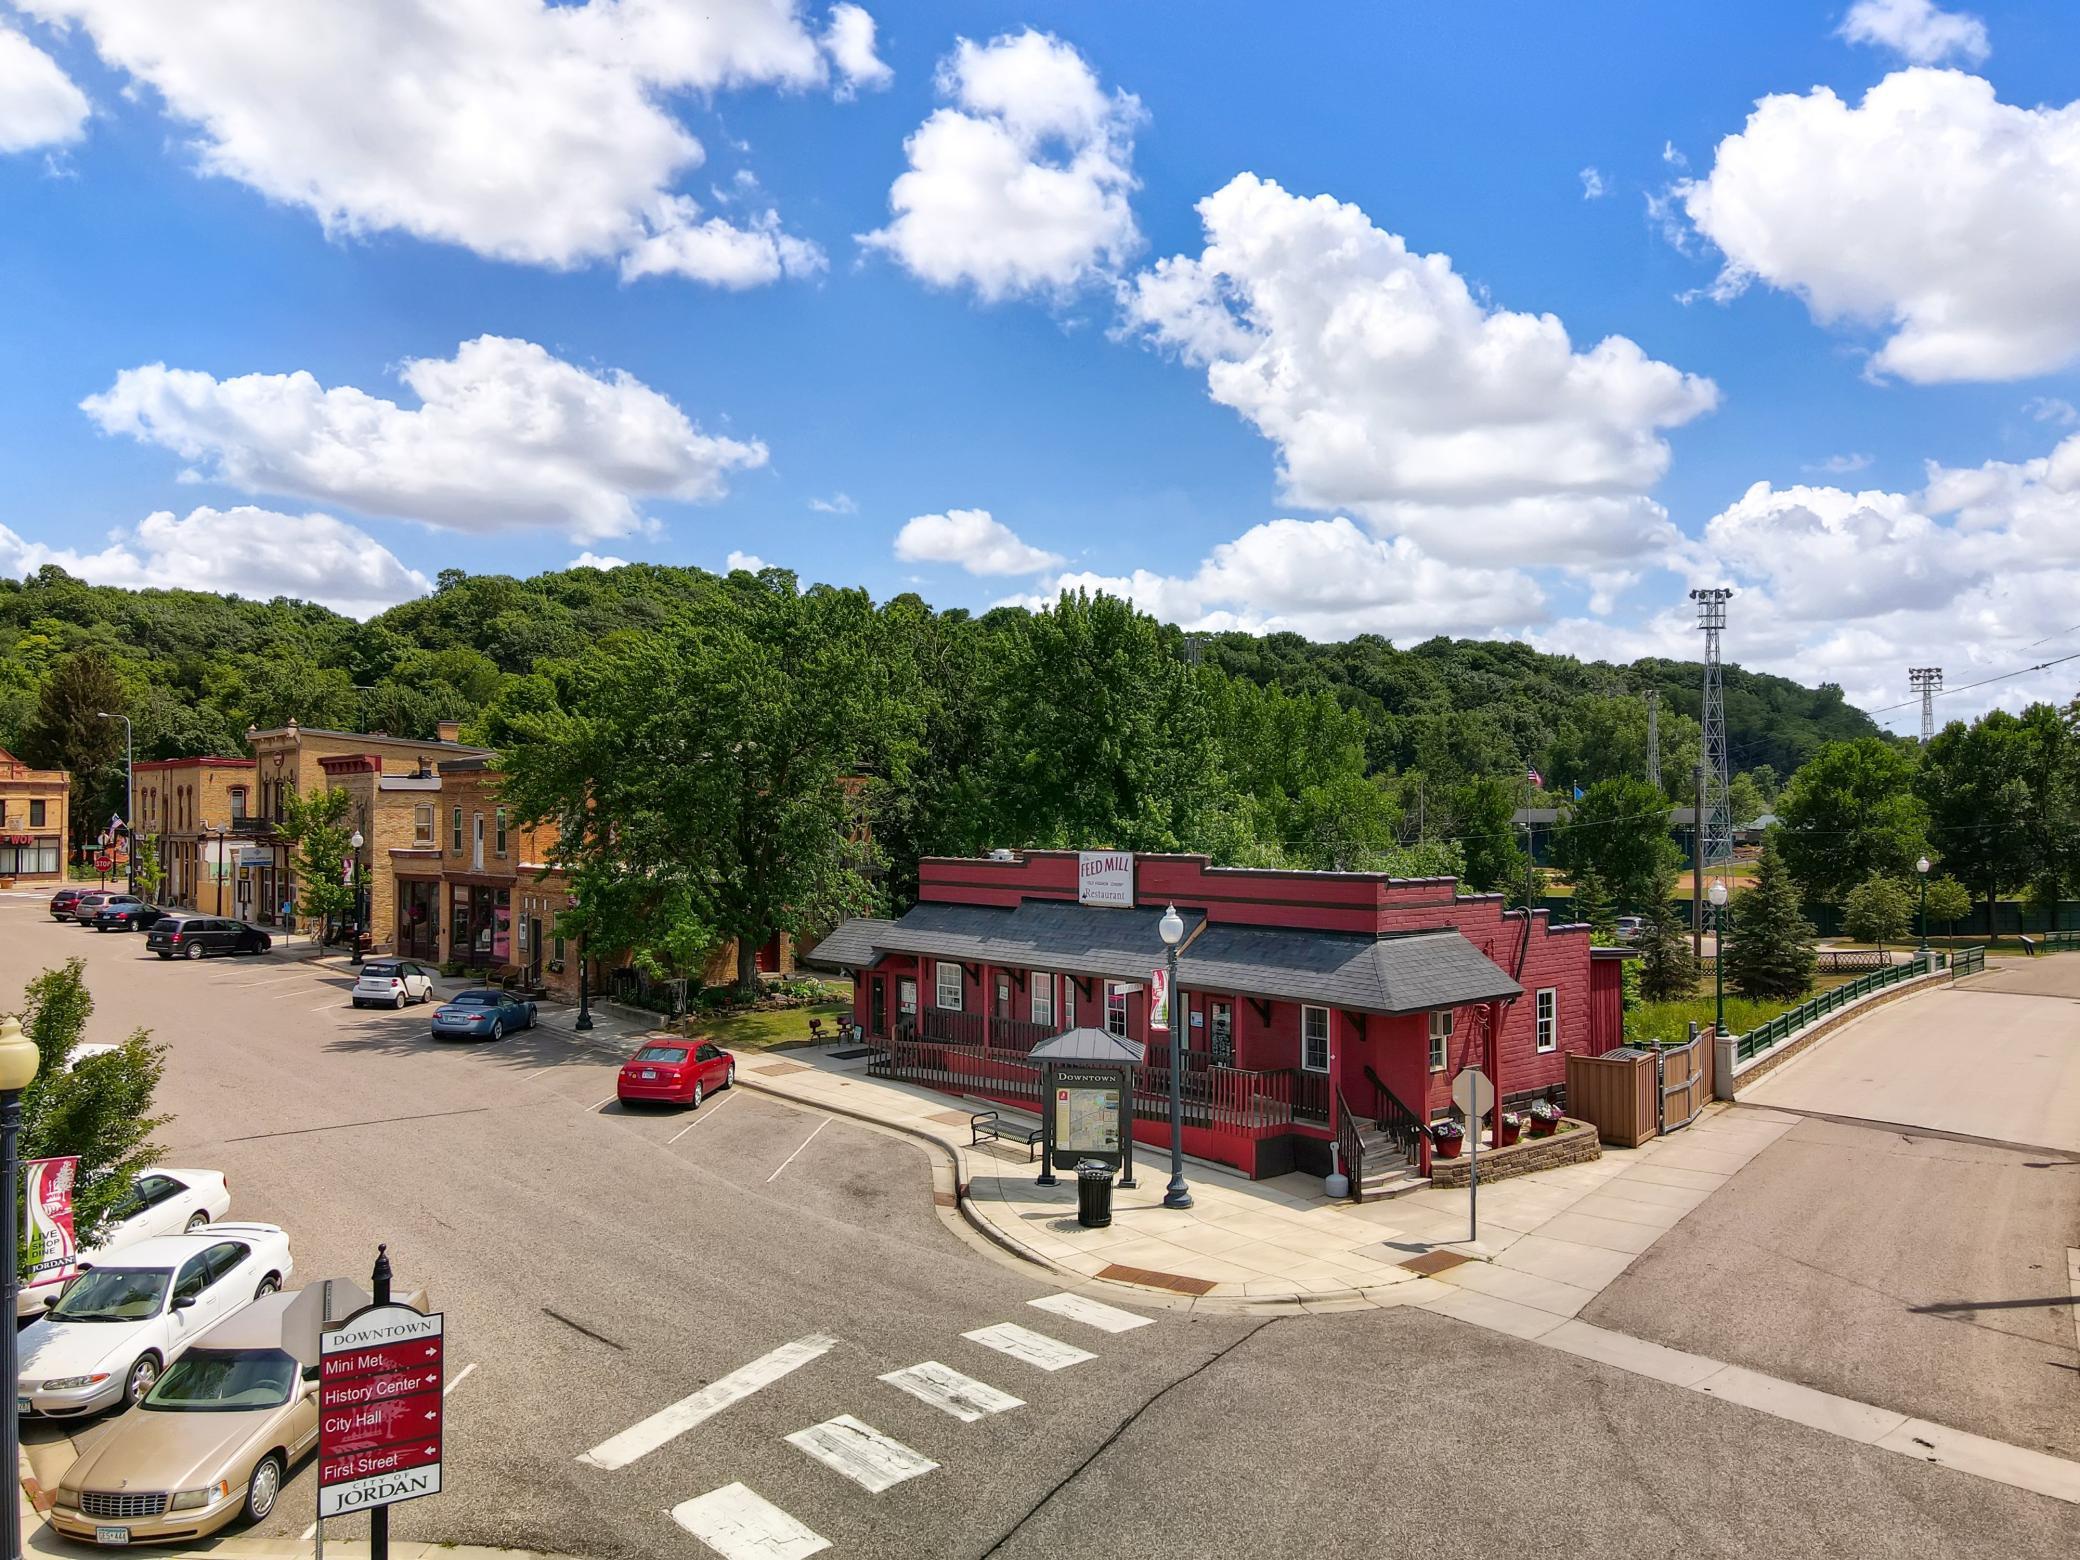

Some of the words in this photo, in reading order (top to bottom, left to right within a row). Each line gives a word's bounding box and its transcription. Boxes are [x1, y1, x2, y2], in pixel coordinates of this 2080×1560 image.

[1081, 860, 1103, 877] FEED
[1105, 857, 1129, 872] MILL
[1085, 888, 1125, 900] Restaurant
[1058, 1072, 1116, 1082] DOWNTOWN
[32, 1229, 57, 1241] LIVE
[32, 1238, 60, 1251] SHOP
[32, 1247, 55, 1258] DINE
[32, 1257, 73, 1272] JORDAN
[333, 1320, 432, 1346] DOWNTOWN
[325, 1358, 354, 1375] Mini
[358, 1354, 383, 1370] Met
[325, 1386, 372, 1404] History
[376, 1377, 420, 1395] Center
[325, 1417, 352, 1433] City
[356, 1410, 382, 1427] Hall
[324, 1462, 353, 1480] First
[358, 1453, 398, 1473] Street
[353, 1477, 386, 1489] CITY
[394, 1472, 410, 1481] OF
[336, 1475, 428, 1511] JORDAN
